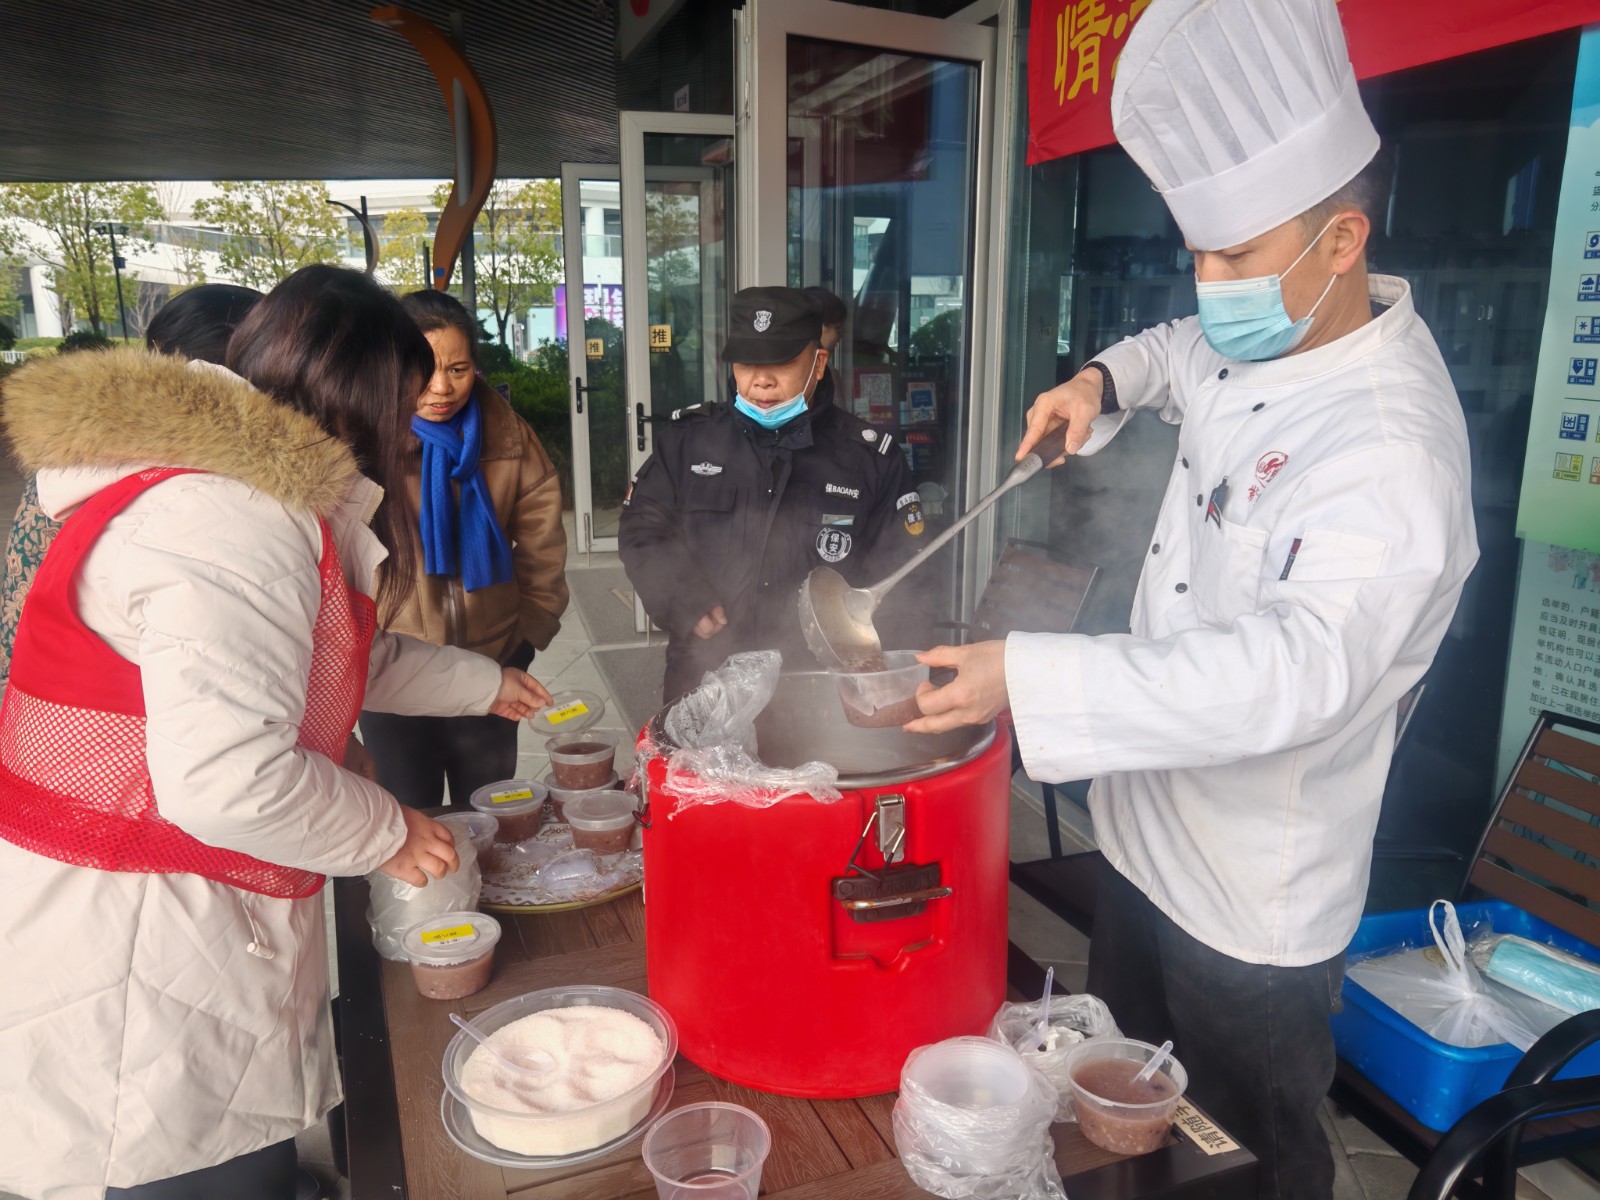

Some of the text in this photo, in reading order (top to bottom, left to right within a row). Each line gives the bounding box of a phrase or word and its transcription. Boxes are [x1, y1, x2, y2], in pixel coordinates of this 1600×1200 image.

[652, 328, 667, 343] 推
[589, 342, 600, 353] 推
[829, 533, 839, 553] 保安
[1541, 612, 1600, 634] 应当及时开具
